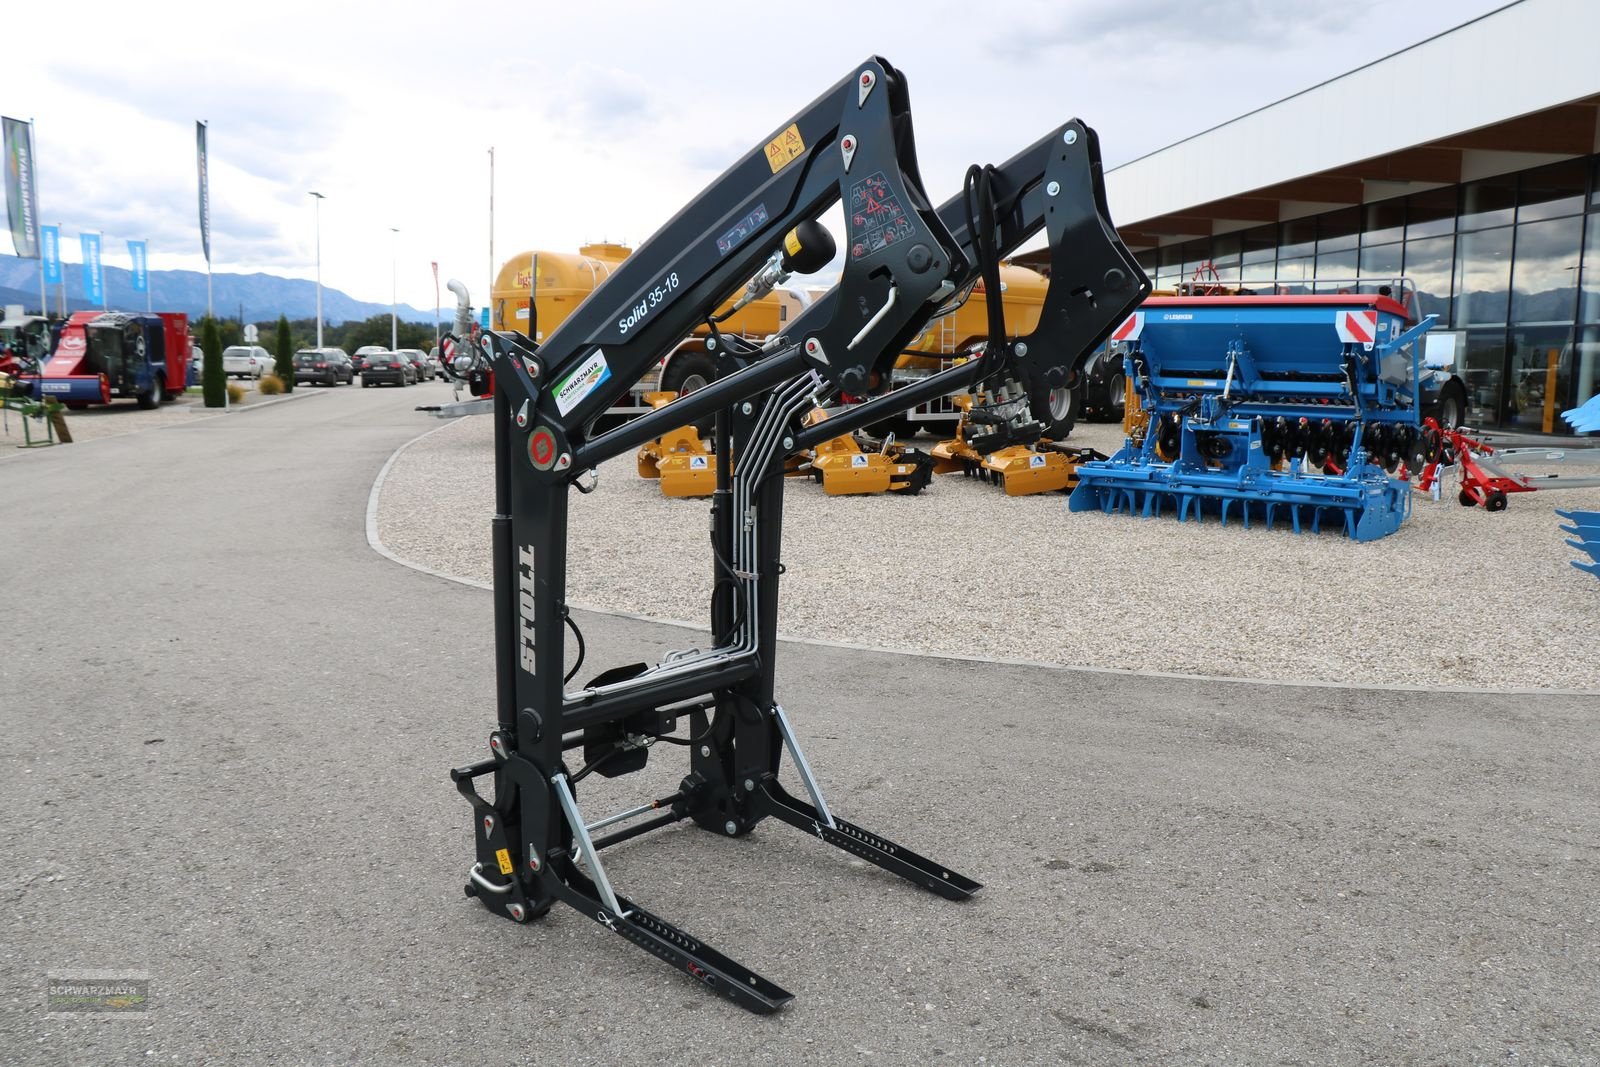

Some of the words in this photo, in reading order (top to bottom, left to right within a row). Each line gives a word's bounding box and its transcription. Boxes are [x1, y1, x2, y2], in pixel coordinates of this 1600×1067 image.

[619, 300, 648, 334] Solid
[648, 272, 679, 307] 35-18
[560, 362, 598, 398] SCHWARZMAYR
[519, 544, 536, 676] STOLL
